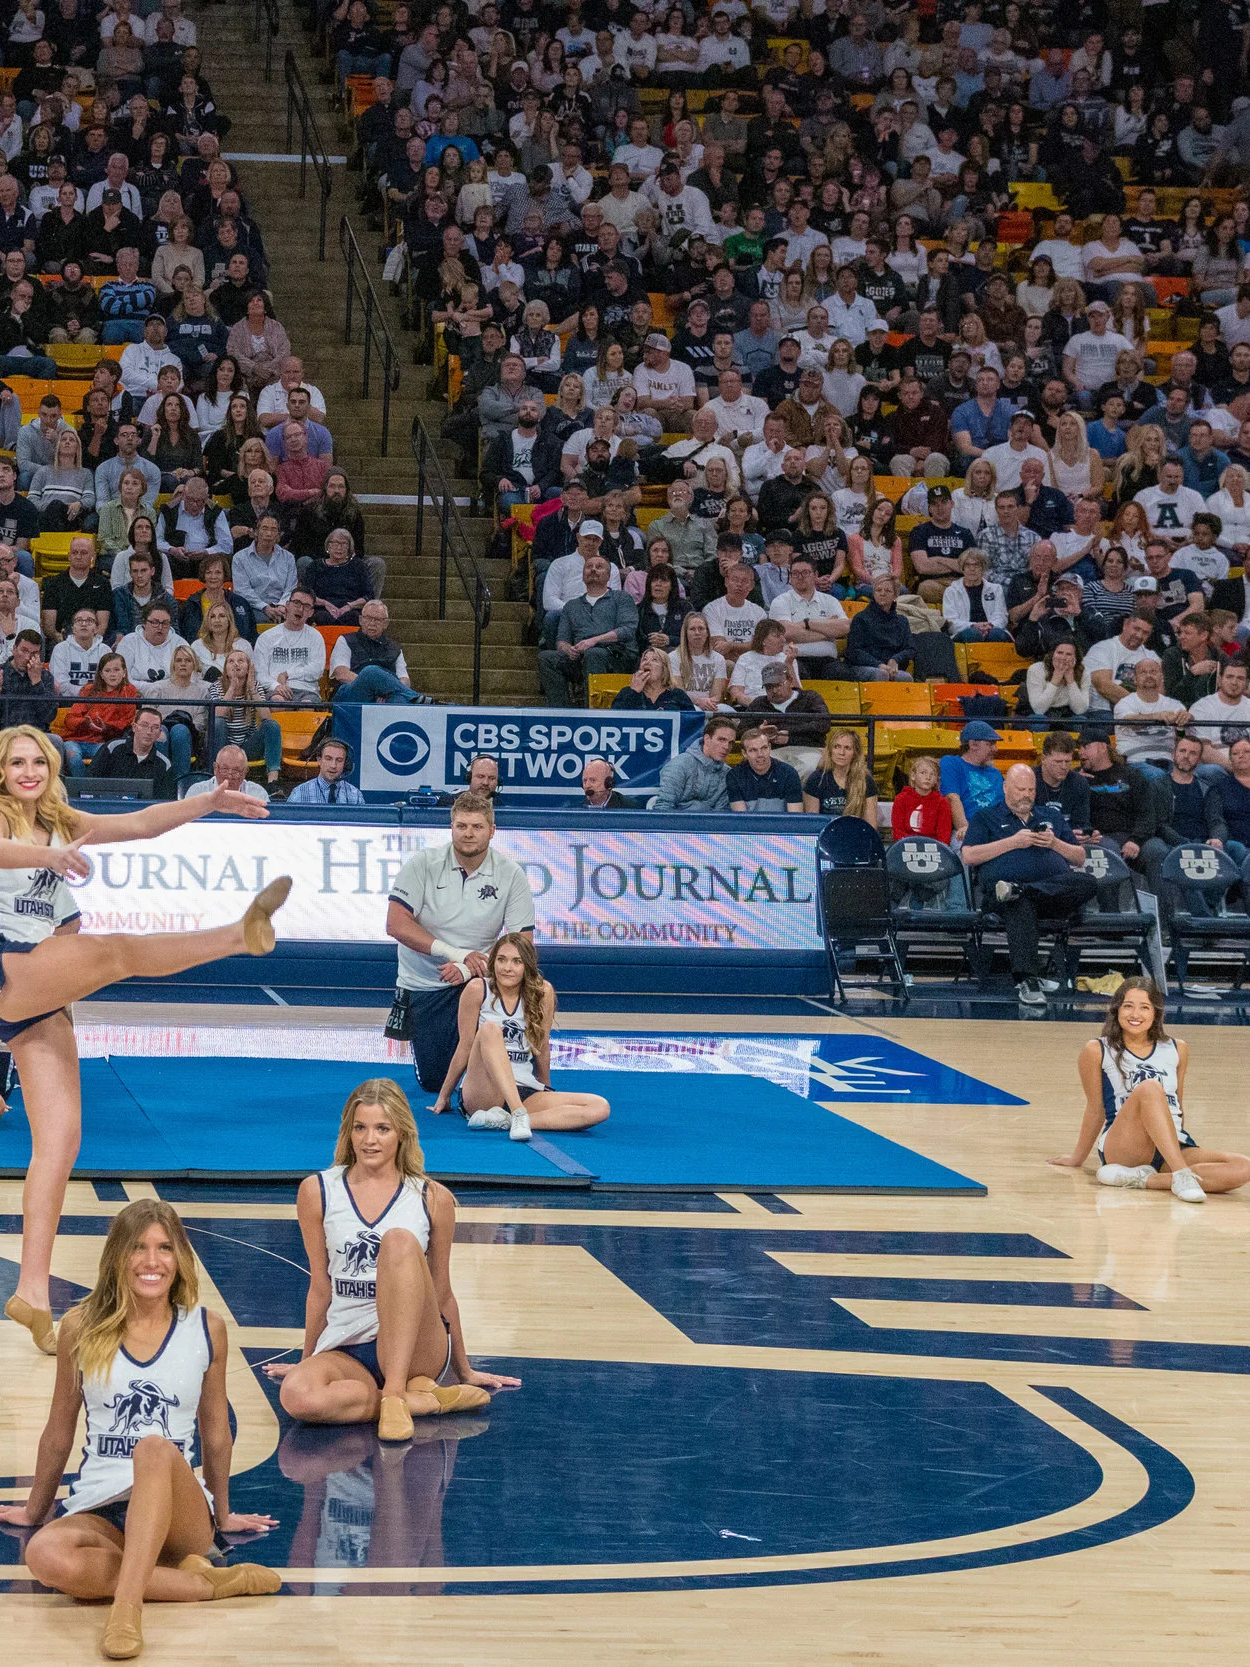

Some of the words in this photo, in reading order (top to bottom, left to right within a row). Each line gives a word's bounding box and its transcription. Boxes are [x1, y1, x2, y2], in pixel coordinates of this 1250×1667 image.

[1153, 503, 1183, 529] A
[726, 627, 752, 637] HOOPS
[68, 670, 96, 681] STAT
[453, 723, 521, 750] CBS
[528, 724, 665, 752] SPORTS
[62, 850, 269, 894] OURNAL
[568, 844, 813, 911] JOURNAL
[15, 897, 44, 917] UTAH
[79, 911, 207, 931] OMMUNITY
[550, 921, 591, 940] THE
[599, 922, 738, 944] COMMUNITY
[335, 1278, 366, 1299] UTAH
[98, 1434, 139, 1458] UTAH
